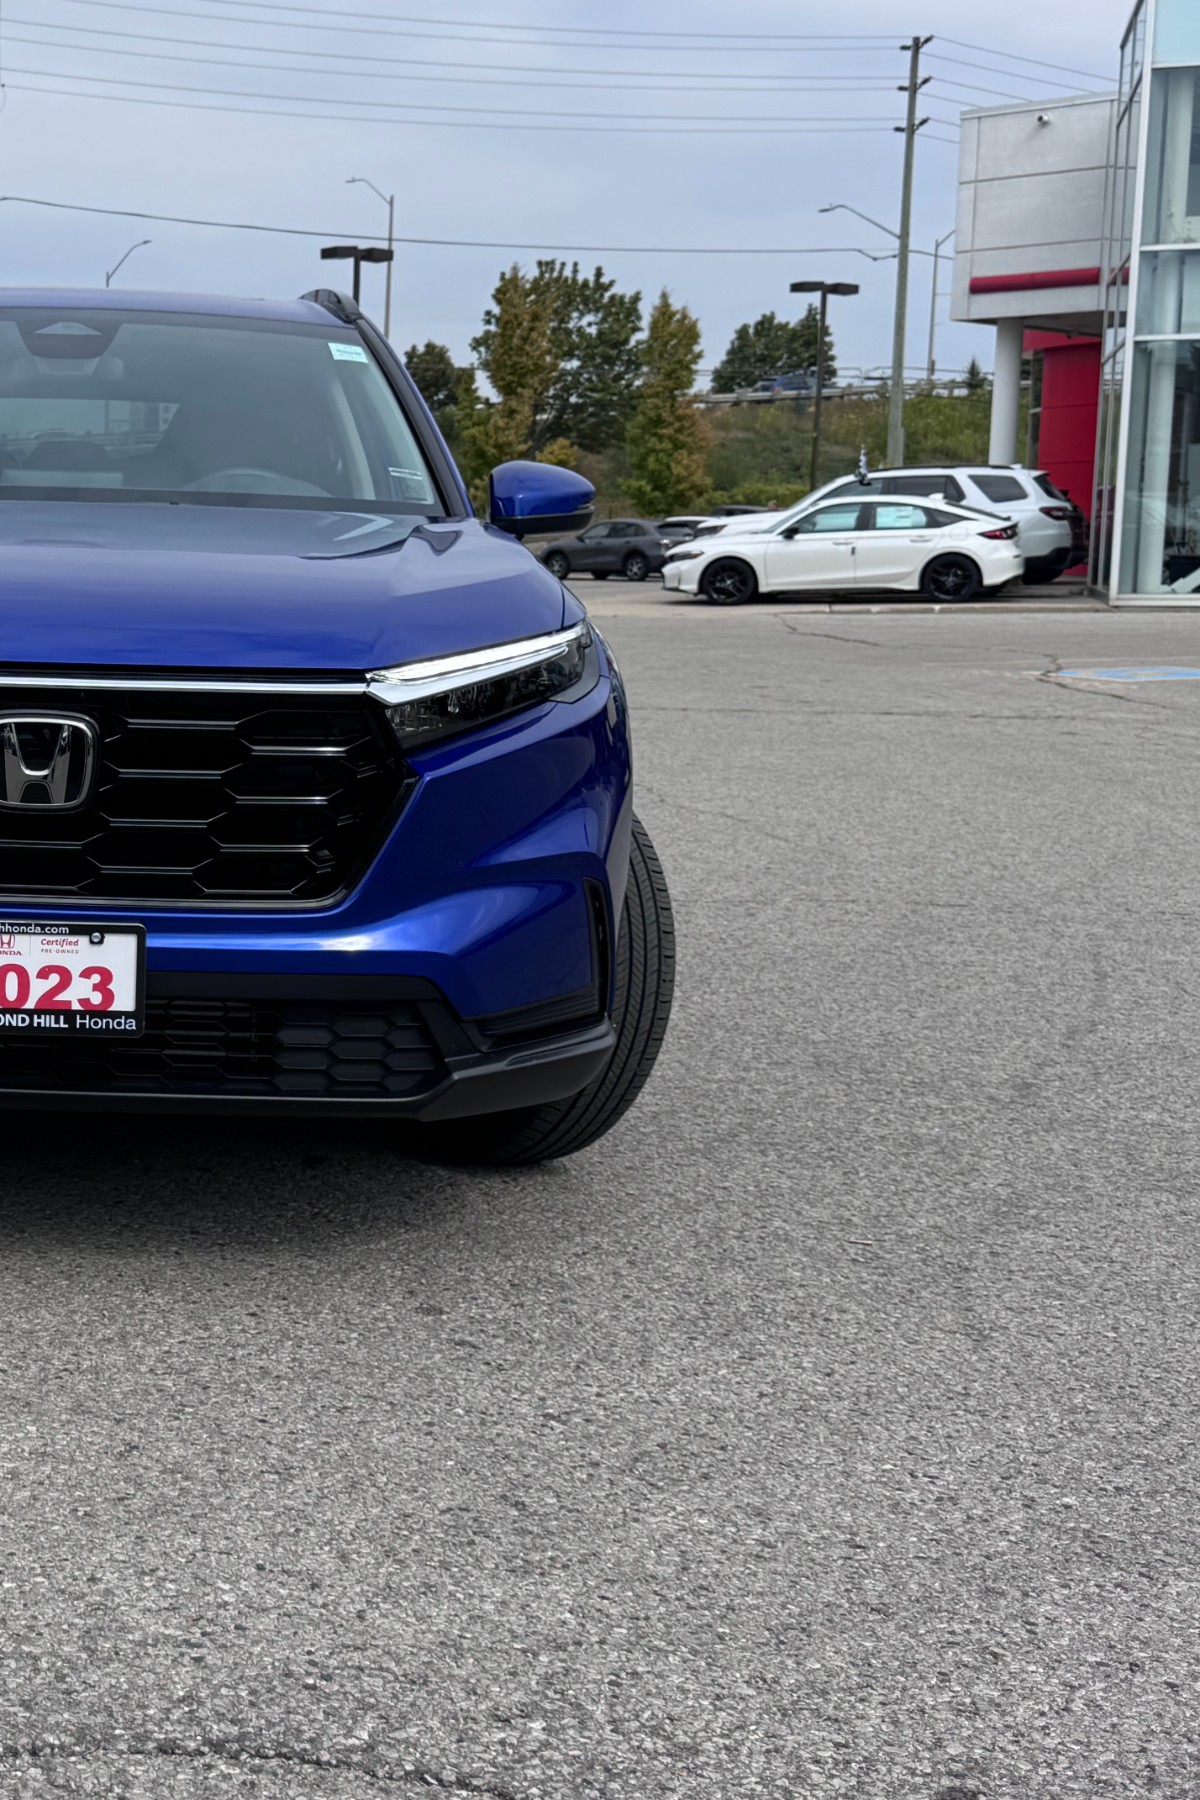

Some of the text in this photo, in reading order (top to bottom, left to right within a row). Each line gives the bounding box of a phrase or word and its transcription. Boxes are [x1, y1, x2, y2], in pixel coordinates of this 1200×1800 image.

[40, 938, 80, 947] Certified
[33, 1014, 69, 1028] HILL
[76, 1014, 137, 1030] Honda
